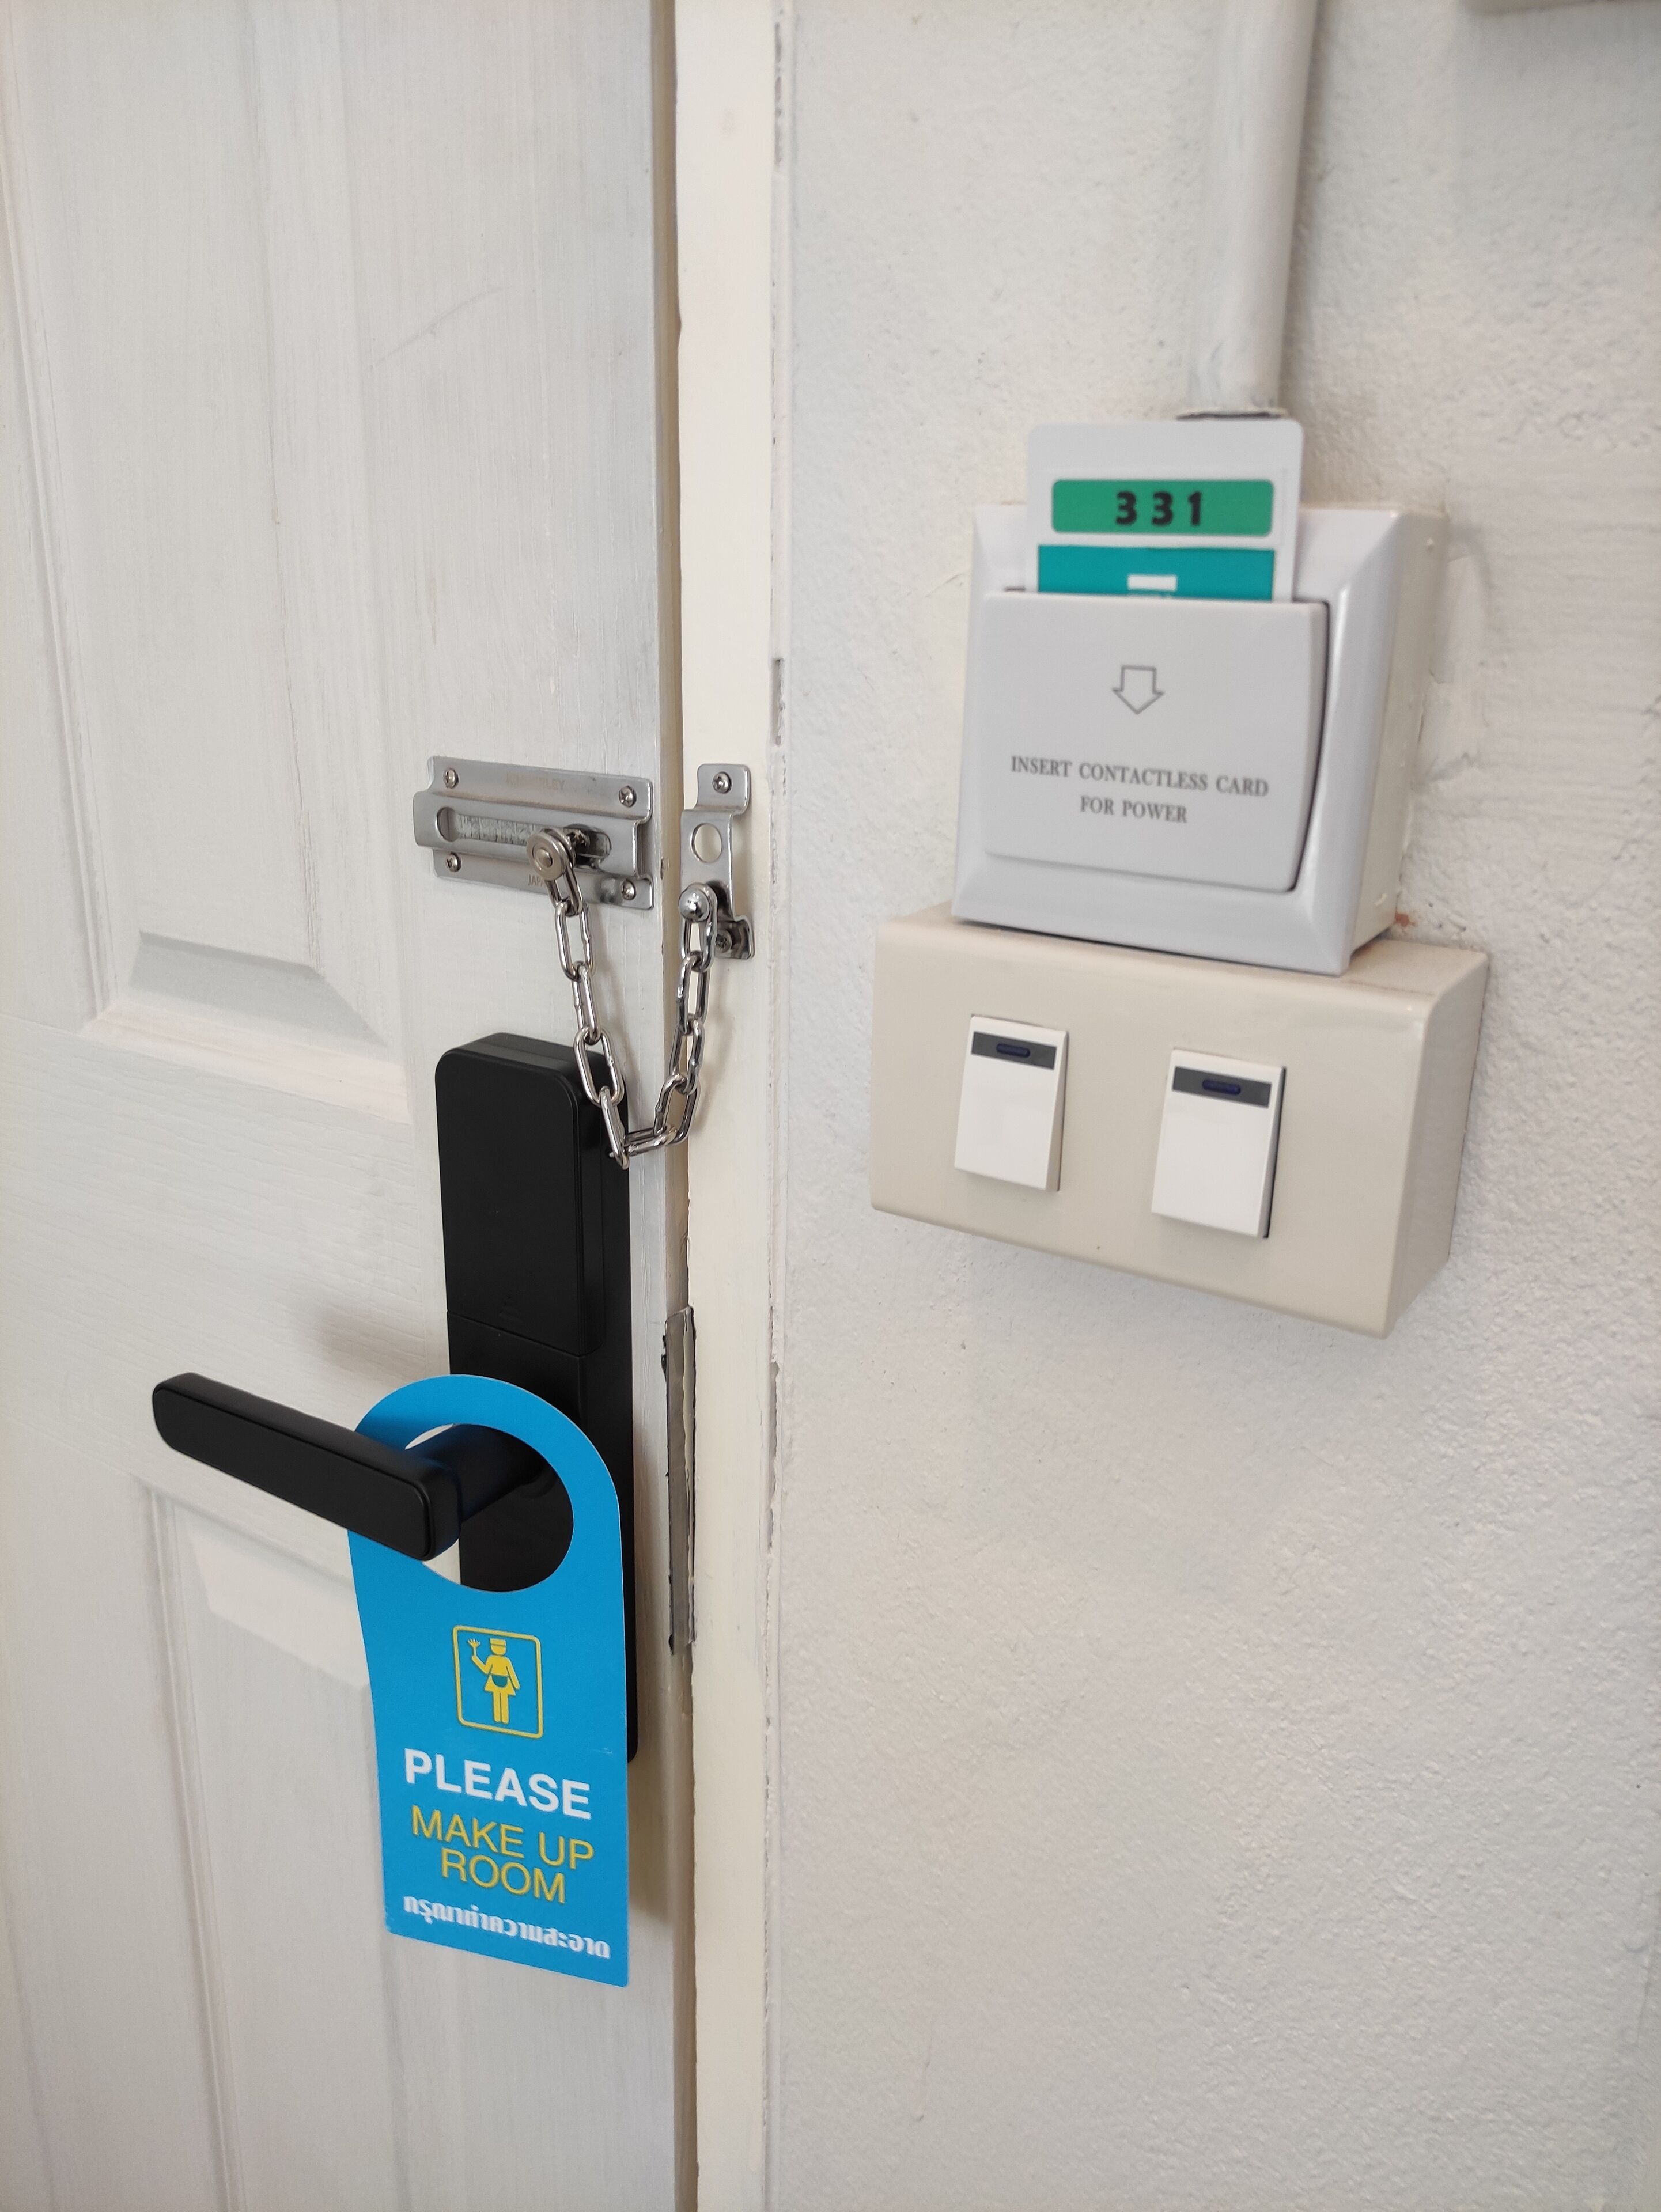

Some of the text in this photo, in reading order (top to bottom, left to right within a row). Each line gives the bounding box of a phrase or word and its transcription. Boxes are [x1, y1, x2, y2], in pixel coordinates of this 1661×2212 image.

[1011, 756, 1269, 797] INSERT CONTACTLESS CARD
[1080, 796, 1187, 823] FOR POWER
[405, 1748, 591, 1819] PLEASE
[411, 1805, 595, 1870] MAKE UP
[441, 1847, 565, 1904] ROOM
